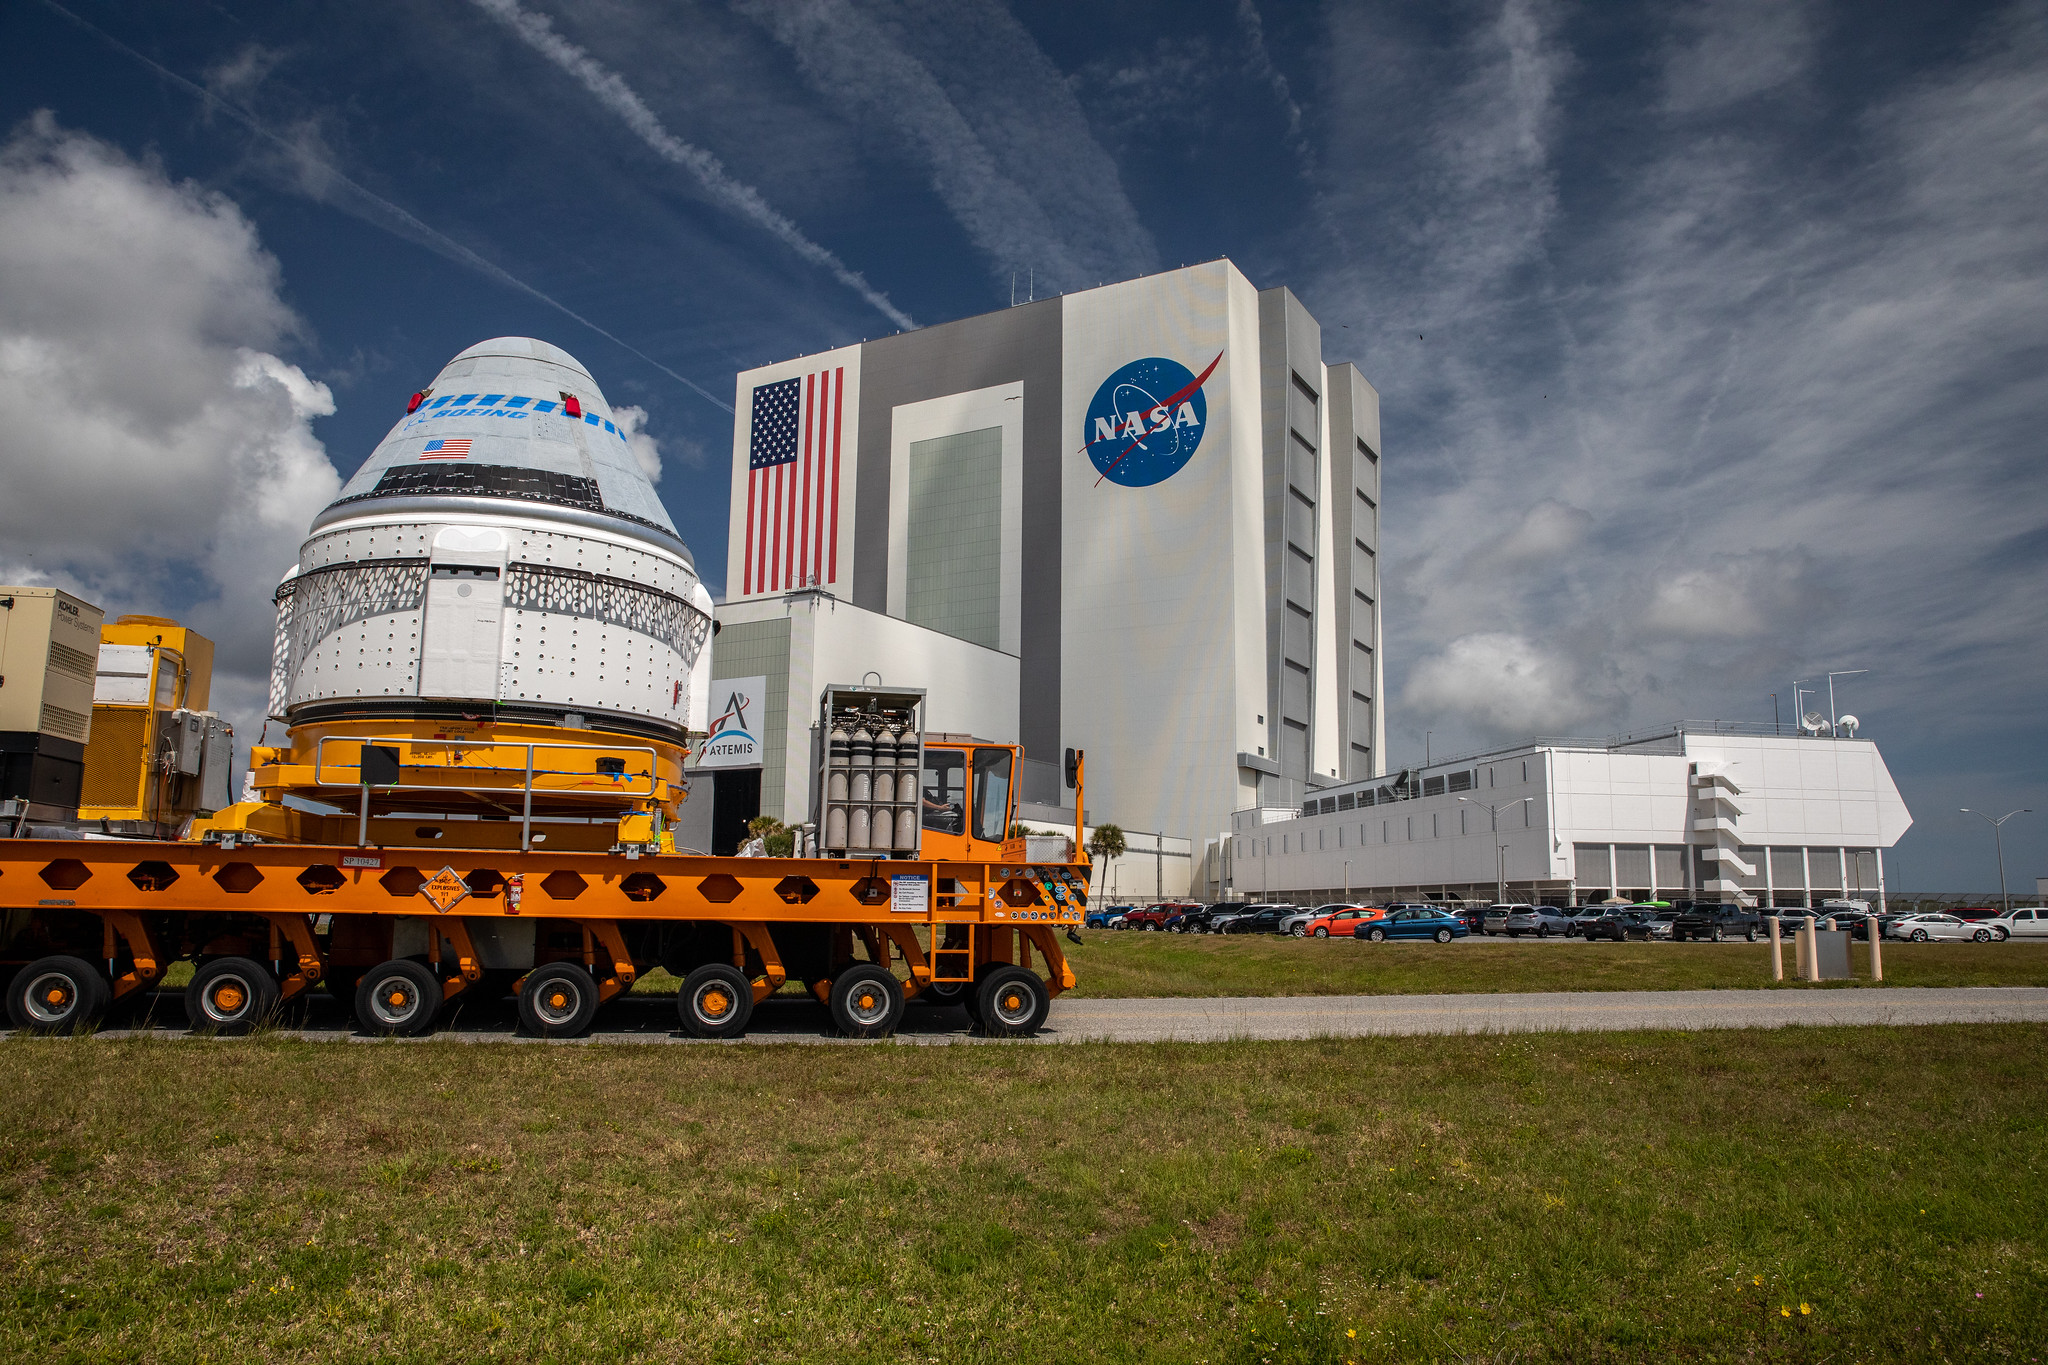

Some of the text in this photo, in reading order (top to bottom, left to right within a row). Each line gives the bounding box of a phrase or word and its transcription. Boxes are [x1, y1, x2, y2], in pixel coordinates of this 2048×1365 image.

[432, 409, 529, 419] BOEING
[1094, 401, 1200, 443] NASA
[59, 600, 79, 616] KOHLER
[57, 610, 95, 634] Power Systems
[709, 743, 753, 756] ARTEMIS
[344, 857, 379, 866] SP 10427
